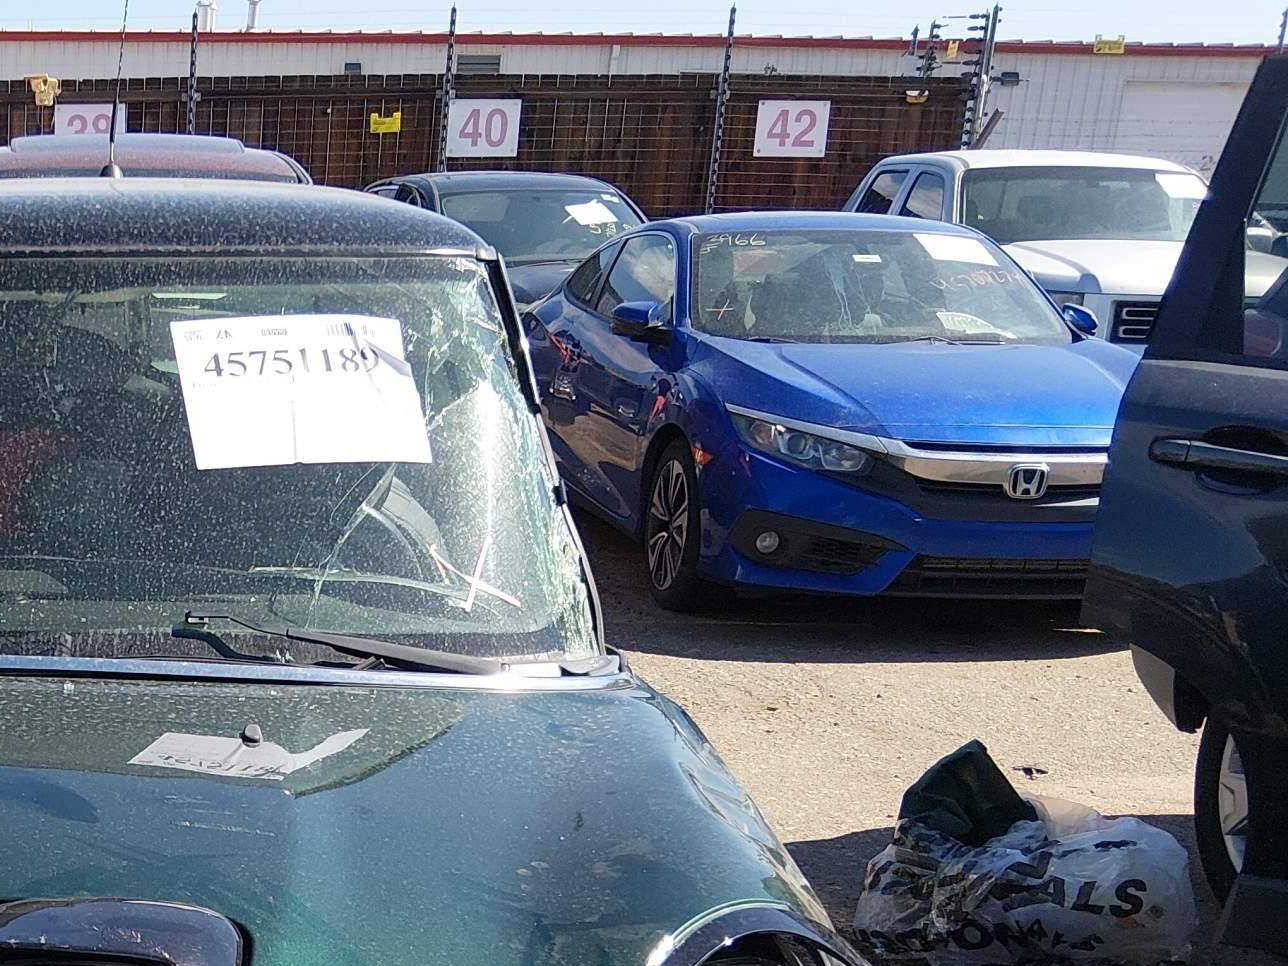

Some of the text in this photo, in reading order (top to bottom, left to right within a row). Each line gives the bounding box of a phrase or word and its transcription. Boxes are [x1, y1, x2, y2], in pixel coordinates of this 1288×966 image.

[458, 108, 508, 147] 40
[767, 109, 817, 147] 42
[204, 347, 379, 377] 45751189
